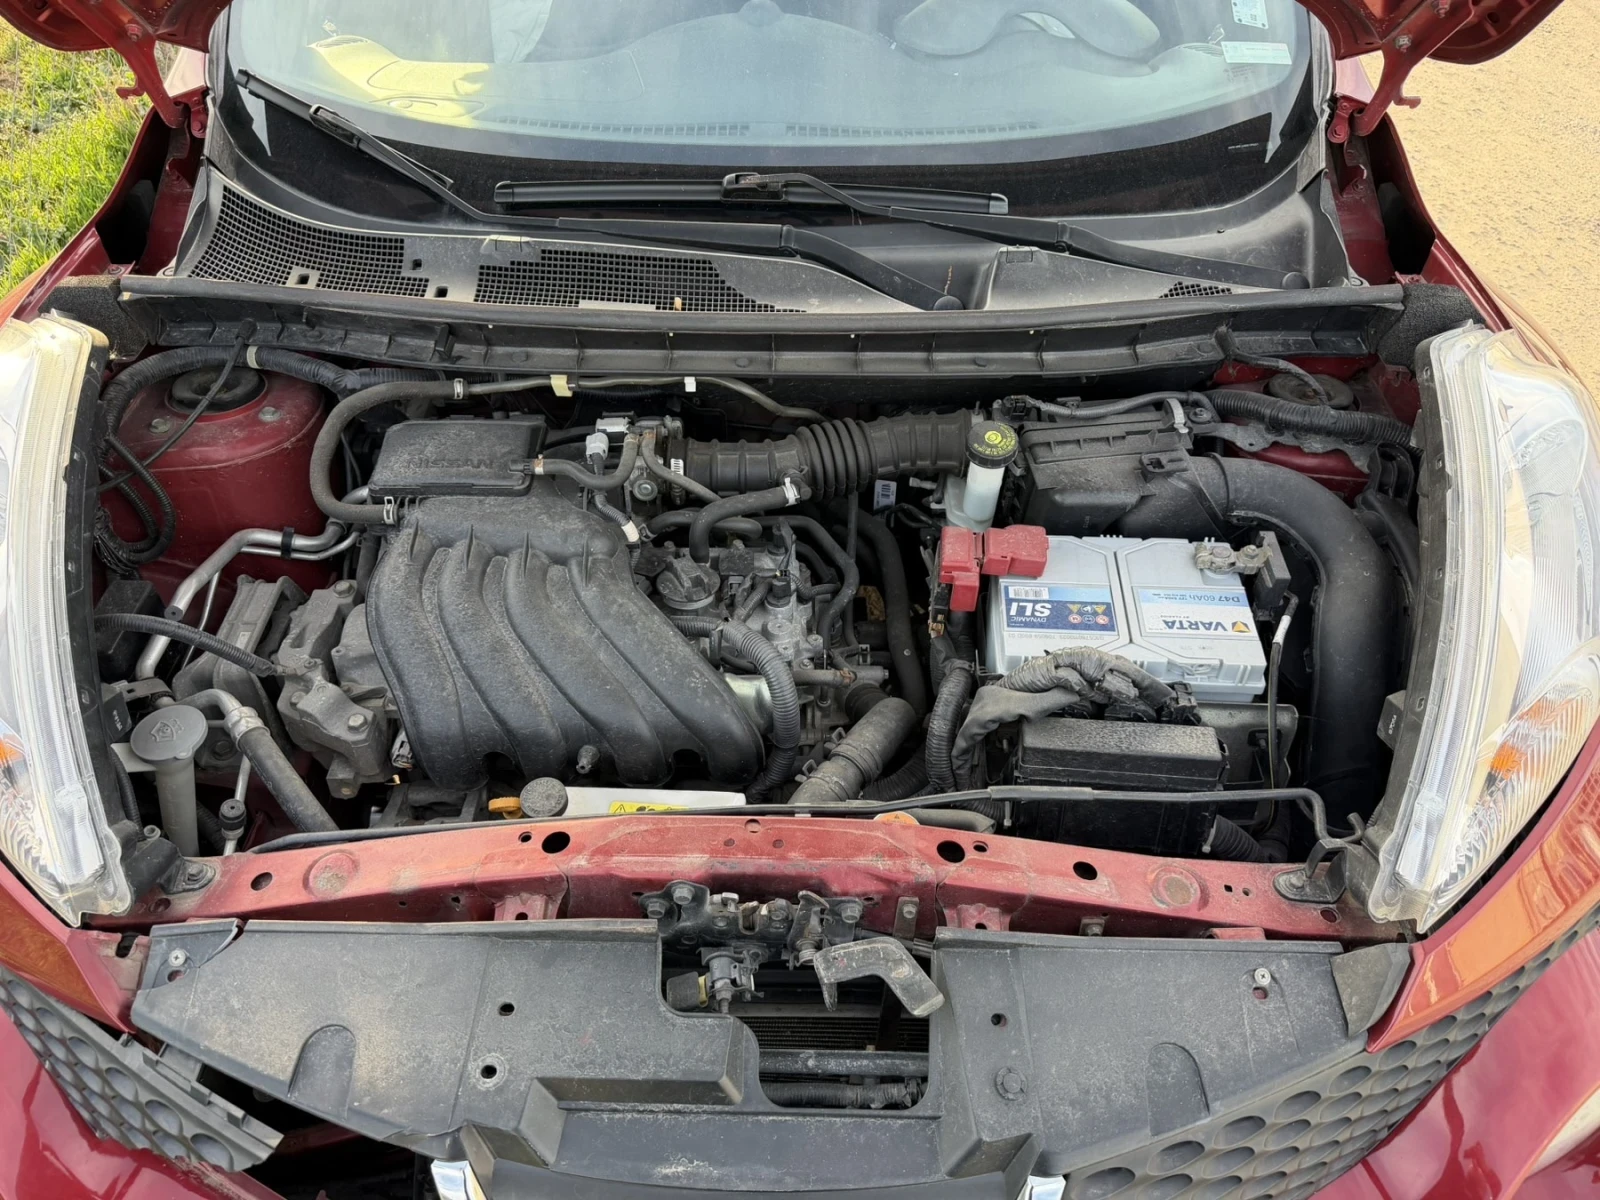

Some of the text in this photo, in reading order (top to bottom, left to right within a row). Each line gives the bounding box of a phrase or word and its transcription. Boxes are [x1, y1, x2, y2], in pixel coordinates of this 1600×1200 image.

[407, 457, 495, 469] NISSAN
[1189, 593, 1216, 602] 60Ah
[1219, 595, 1241, 603] D47
[1009, 602, 1052, 617] SLI
[1162, 619, 1228, 632] VARTA
